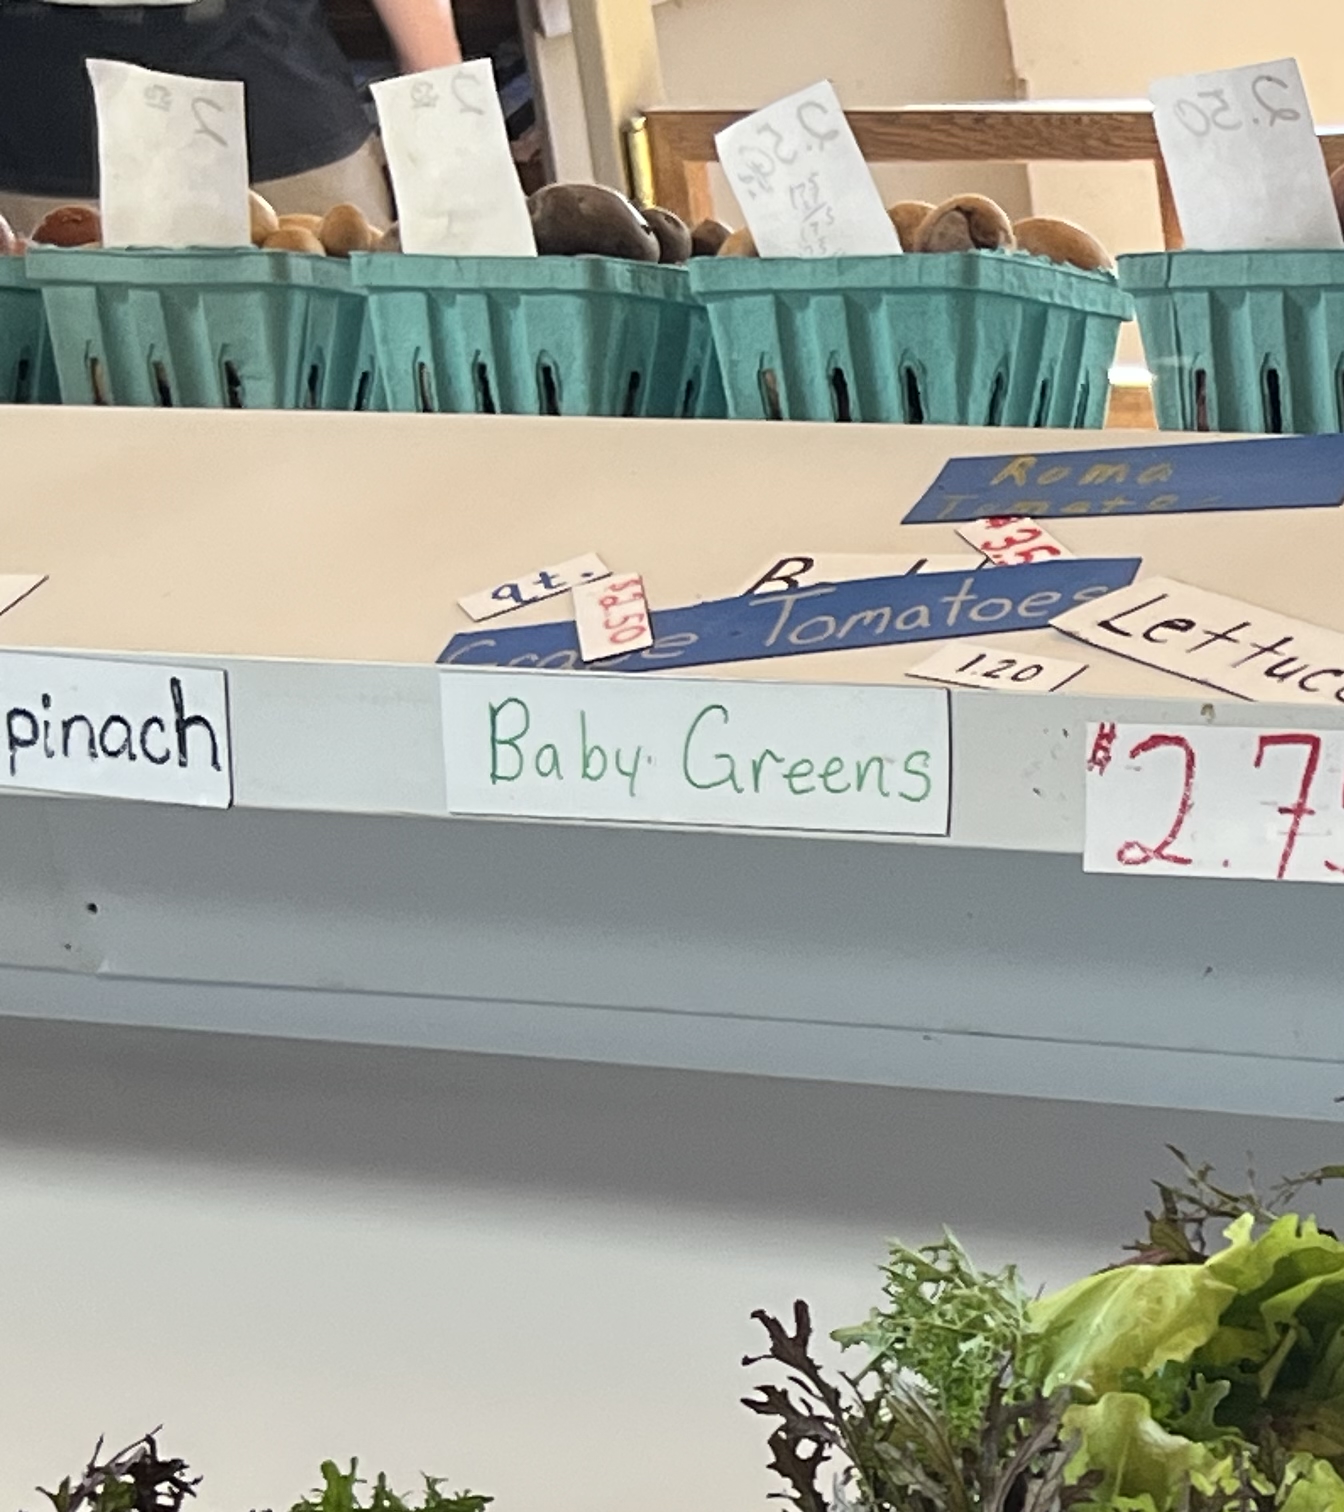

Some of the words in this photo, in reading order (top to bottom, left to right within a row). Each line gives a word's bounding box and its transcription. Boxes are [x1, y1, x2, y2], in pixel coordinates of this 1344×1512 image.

[989, 455, 1175, 488] Roma
[6, 676, 222, 777] pinach
[488, 696, 642, 798] Baby
[682, 704, 934, 803] Greens
